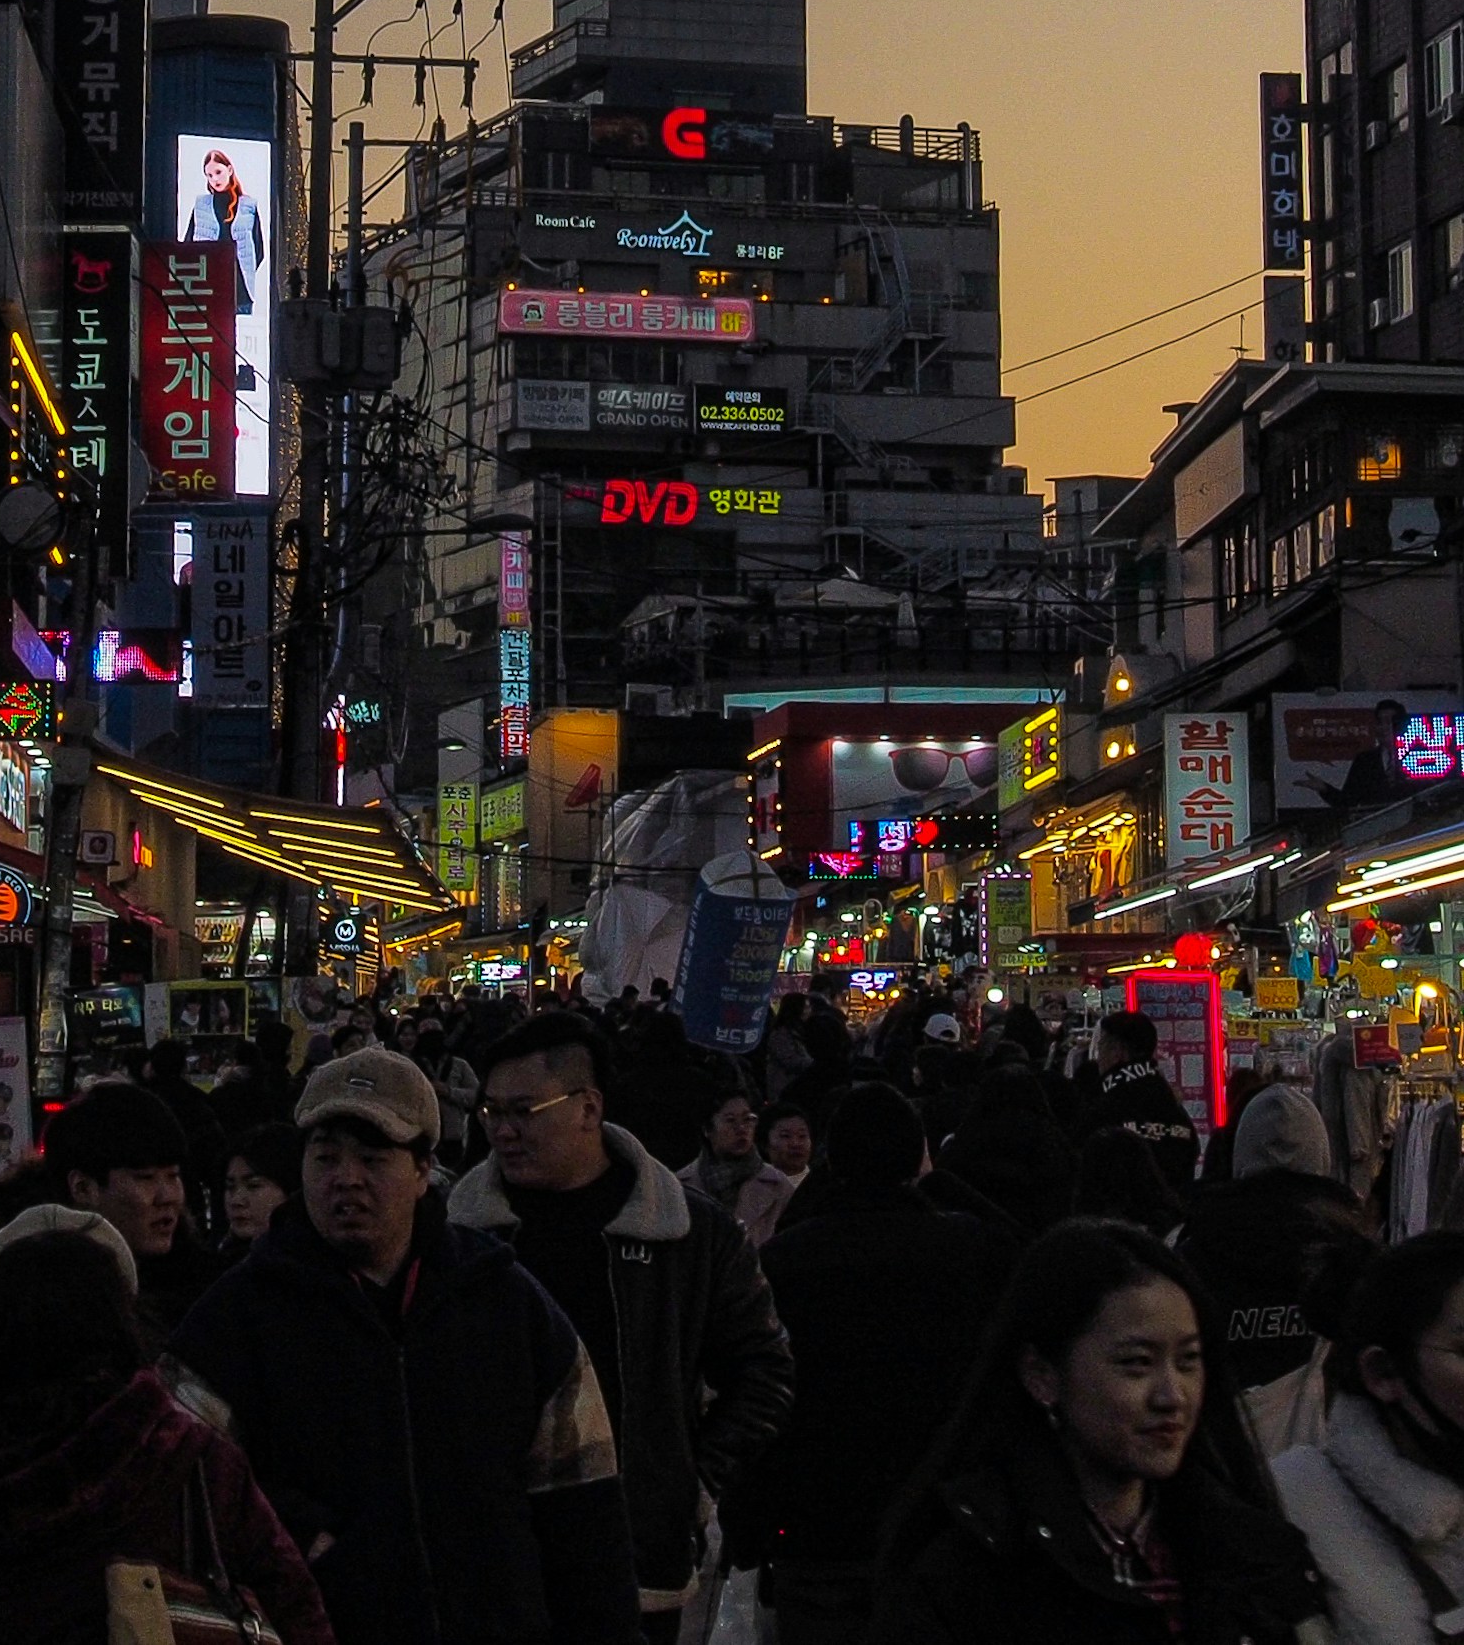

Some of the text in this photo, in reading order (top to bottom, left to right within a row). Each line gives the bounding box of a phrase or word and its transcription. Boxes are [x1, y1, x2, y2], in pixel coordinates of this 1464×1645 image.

[1270, 113, 1300, 260] 호미화방
[535, 214, 596, 229] Room Cafe
[617, 227, 697, 253] Roomvely
[768, 245, 784, 260] 8F
[555, 299, 633, 328] 룸블리
[640, 304, 716, 332] 룸카페
[161, 255, 214, 460] 보드게임
[597, 390, 687, 413] 엑스케이프
[724, 390, 763, 404] 예약문의
[596, 412, 647, 426] GRAND
[649, 414, 689, 429] OPEN
[699, 405, 785, 422] 02.336.0502
[159, 470, 217, 491] Cafe
[600, 478, 700, 527] DVD
[708, 488, 782, 515] 영화관
[206, 519, 254, 541] LINA
[213, 545, 247, 679] 네일아트
[1177, 718, 1236, 877] 할매순대
[1, 871, 25, 894] eco
